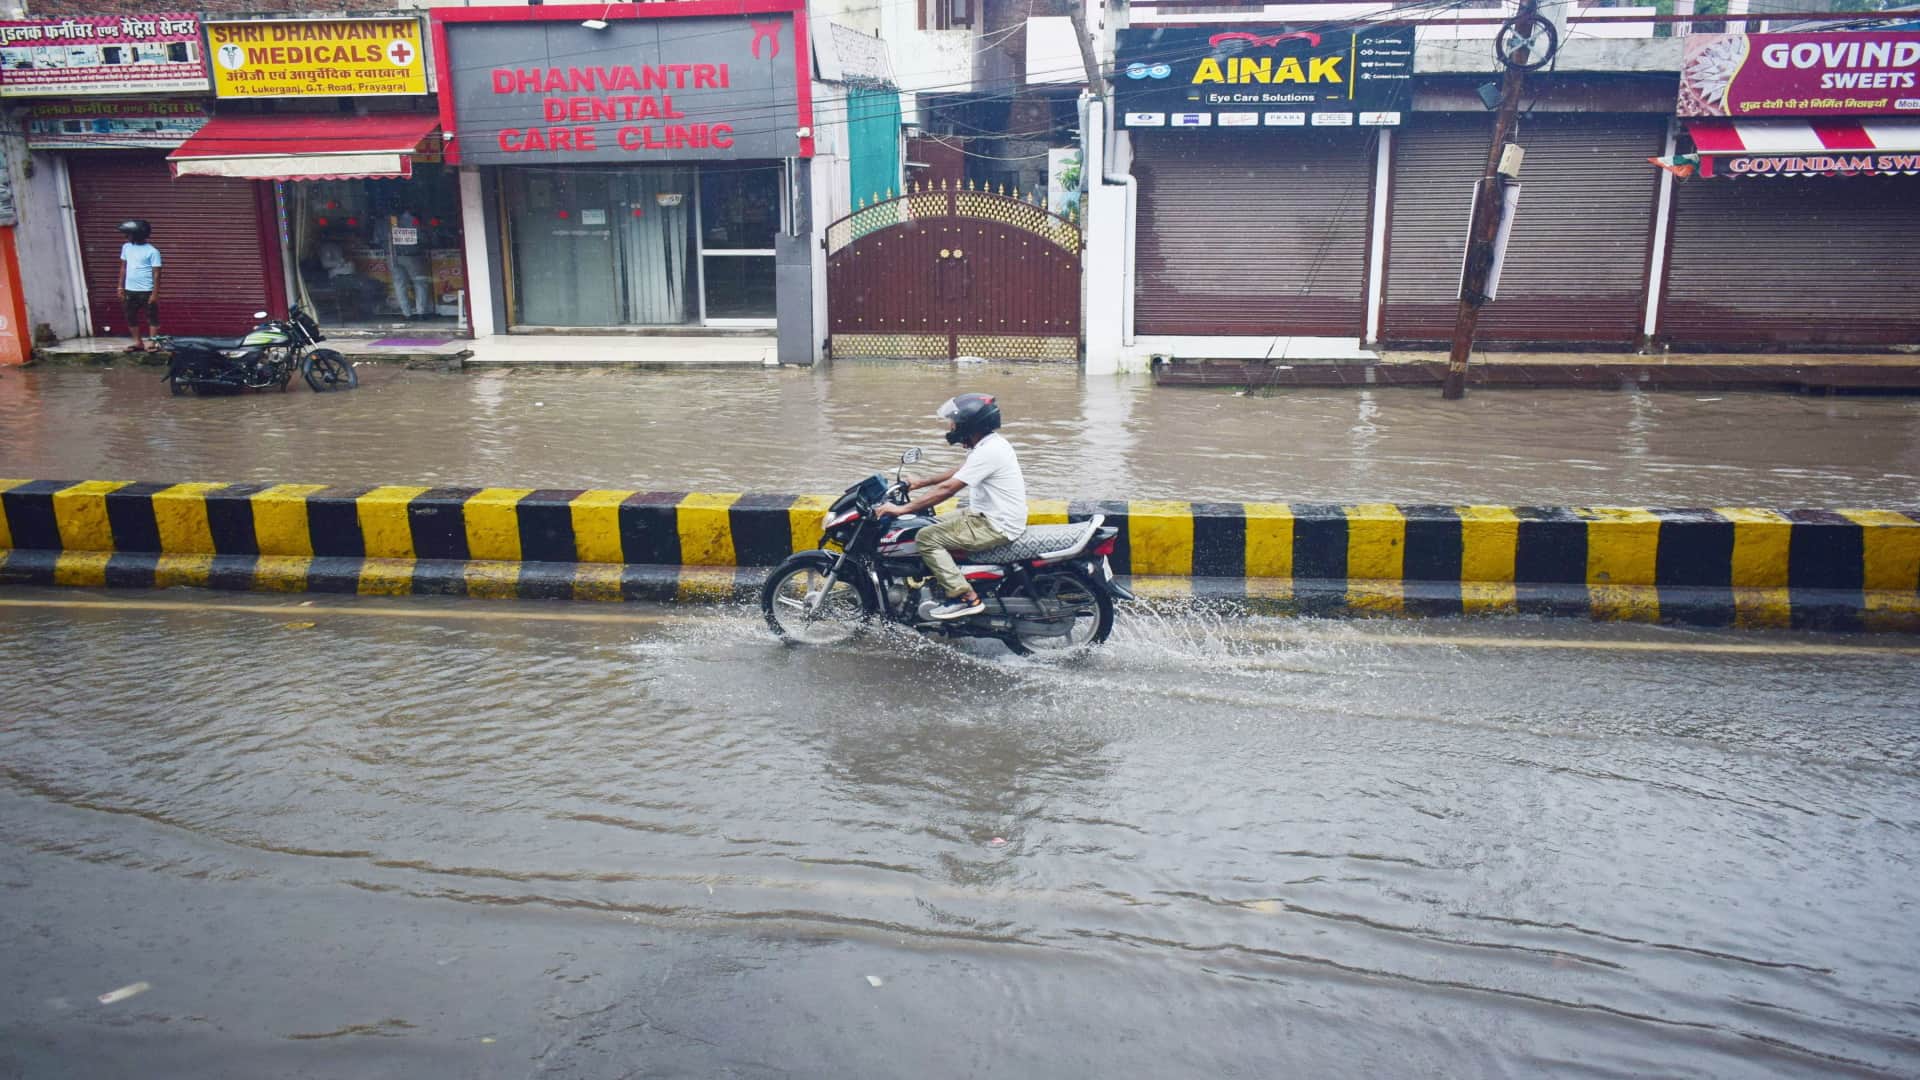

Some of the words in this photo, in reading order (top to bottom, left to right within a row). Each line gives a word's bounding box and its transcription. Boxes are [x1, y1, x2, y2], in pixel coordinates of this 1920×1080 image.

[43, 20, 94, 39] फर्नीचर
[159, 16, 196, 35] सेन्टर
[215, 24, 265, 43] SHRI
[272, 22, 414, 42] DHANVANTRI
[248, 45, 383, 65] MEDICALS
[1762, 41, 1920, 69] GOVIND
[226, 69, 265, 81] अंग्रेजी
[269, 68, 288, 80] एवं
[355, 68, 410, 79] दवाखाना
[491, 63, 730, 94] DHANVANTRI
[1191, 56, 1344, 84] AINAK
[234, 86, 249, 94] 12,
[252, 85, 304, 94] Lukerganj,
[306, 84, 325, 92] G.T.
[358, 83, 407, 93] Prayagraj
[1821, 72, 1915, 89] SWEETS
[1210, 94, 1231, 103] Eye
[1233, 94, 1259, 102] Care
[1262, 93, 1315, 102] Solutions
[1763, 98, 1783, 109] देशी
[1785, 98, 1797, 109] घी
[1798, 98, 1808, 109] से
[543, 95, 685, 122] DENTAL
[497, 126, 597, 153] CARE
[616, 123, 735, 151] CLINIC
[1729, 154, 1875, 173] GOVINDAM
